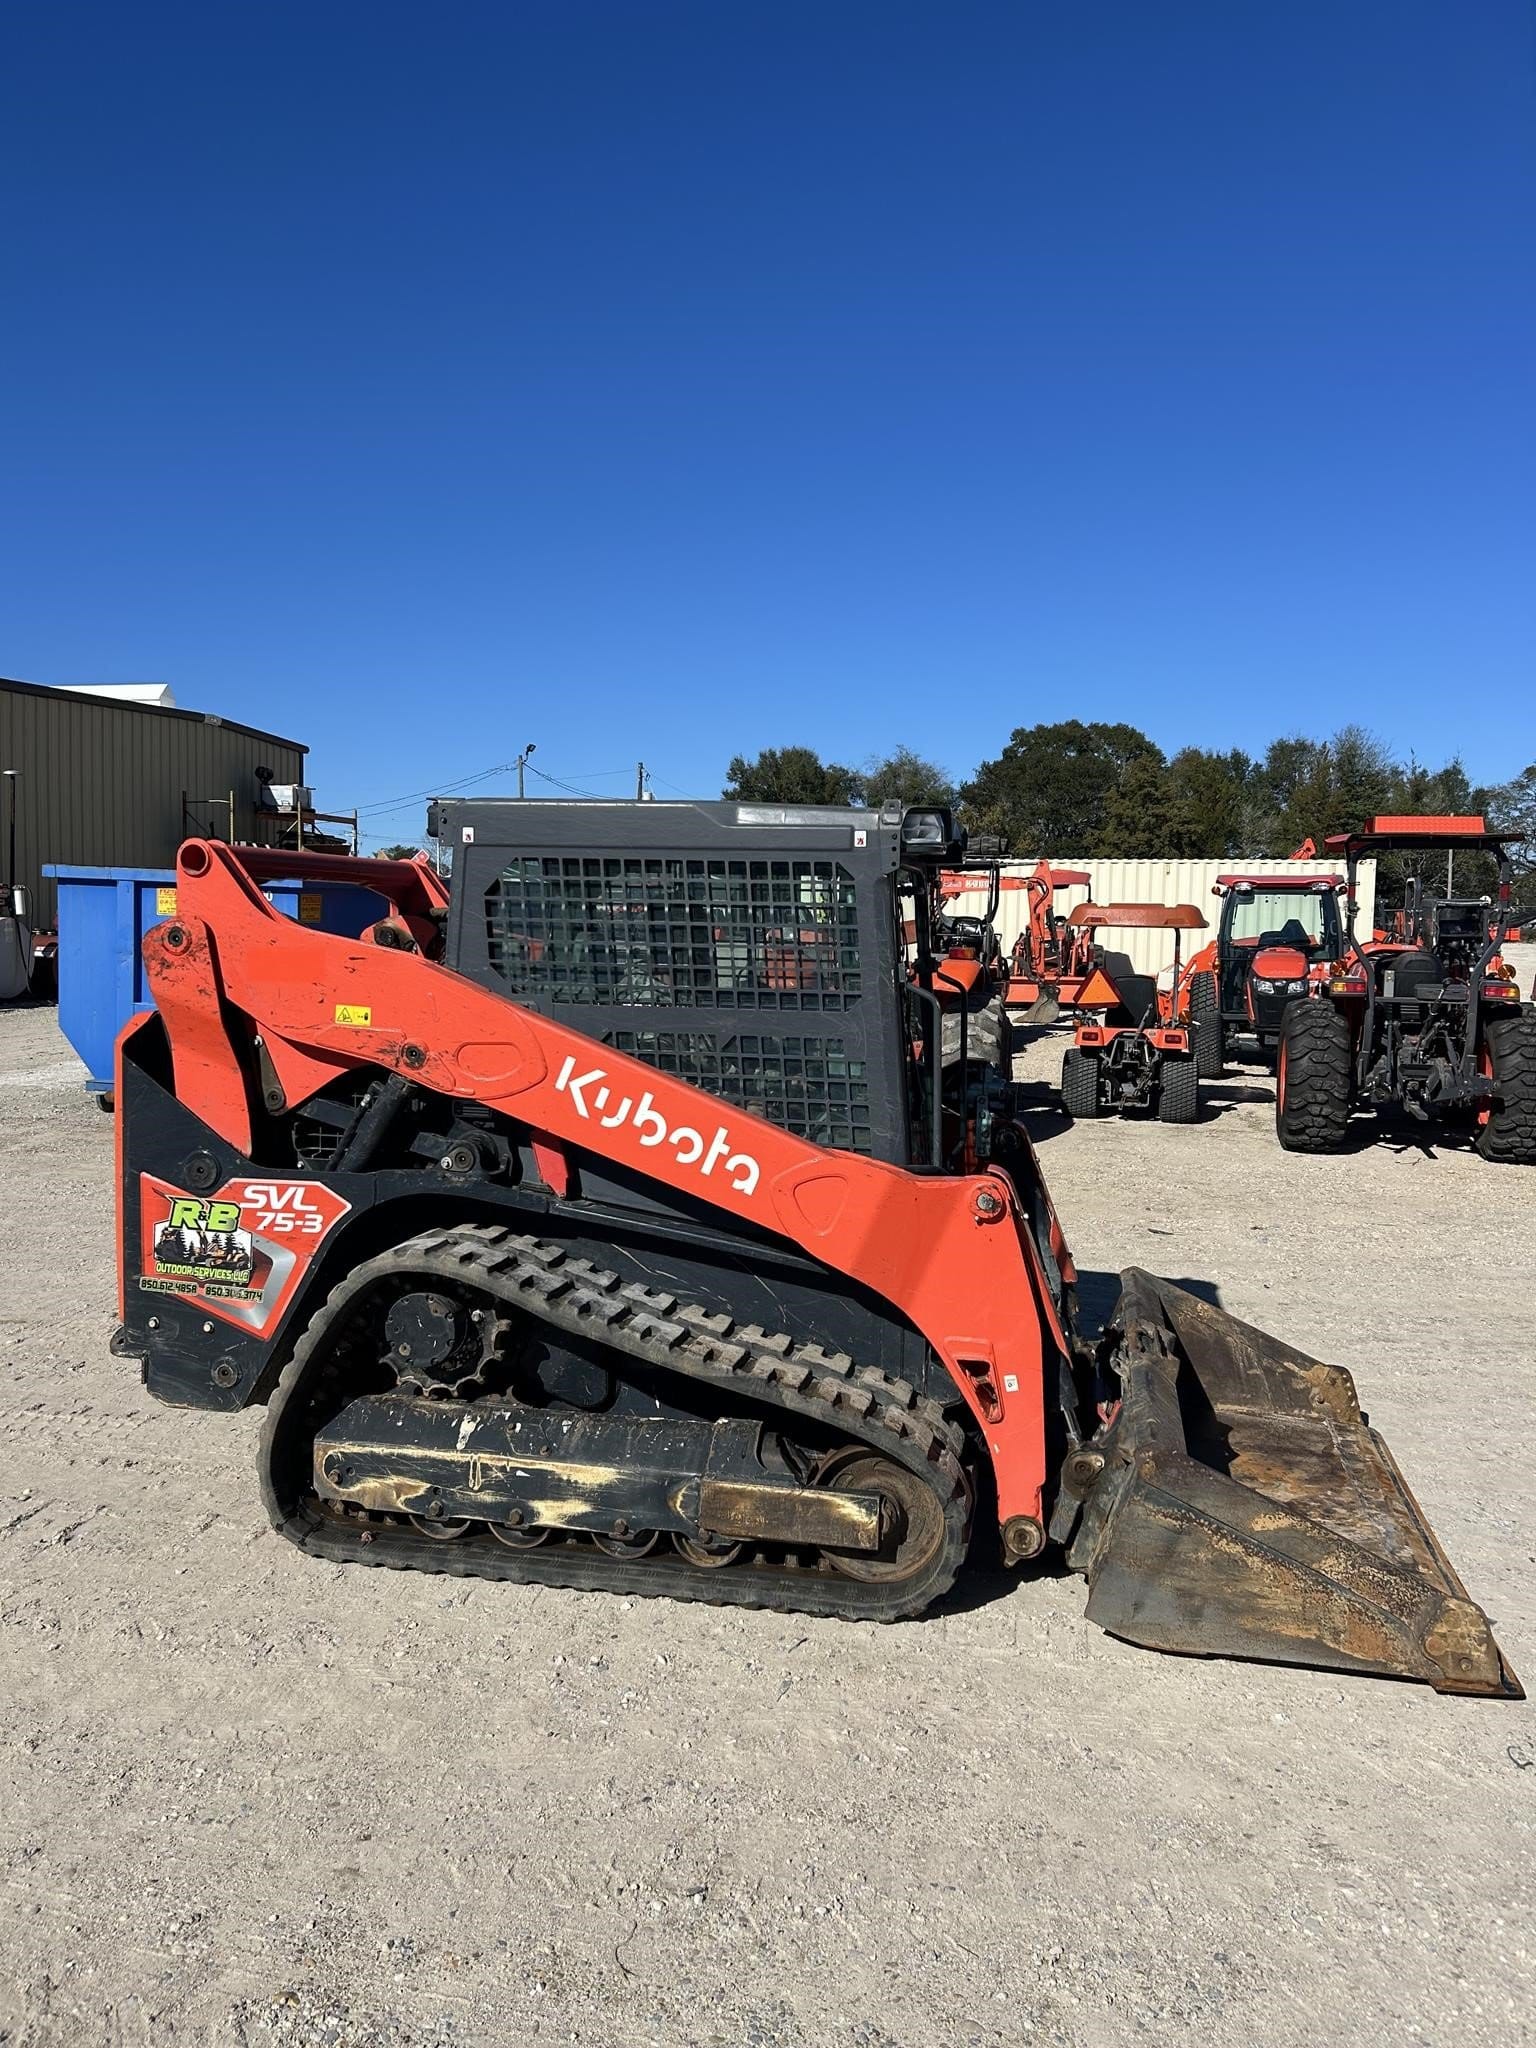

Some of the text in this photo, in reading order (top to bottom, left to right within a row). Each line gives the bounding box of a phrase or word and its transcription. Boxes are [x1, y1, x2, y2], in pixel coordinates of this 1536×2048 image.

[554, 1056, 761, 1196] Kubota
[240, 1185, 318, 1211] SVL
[171, 1199, 240, 1231] R&B
[255, 1211, 323, 1233] 75-3
